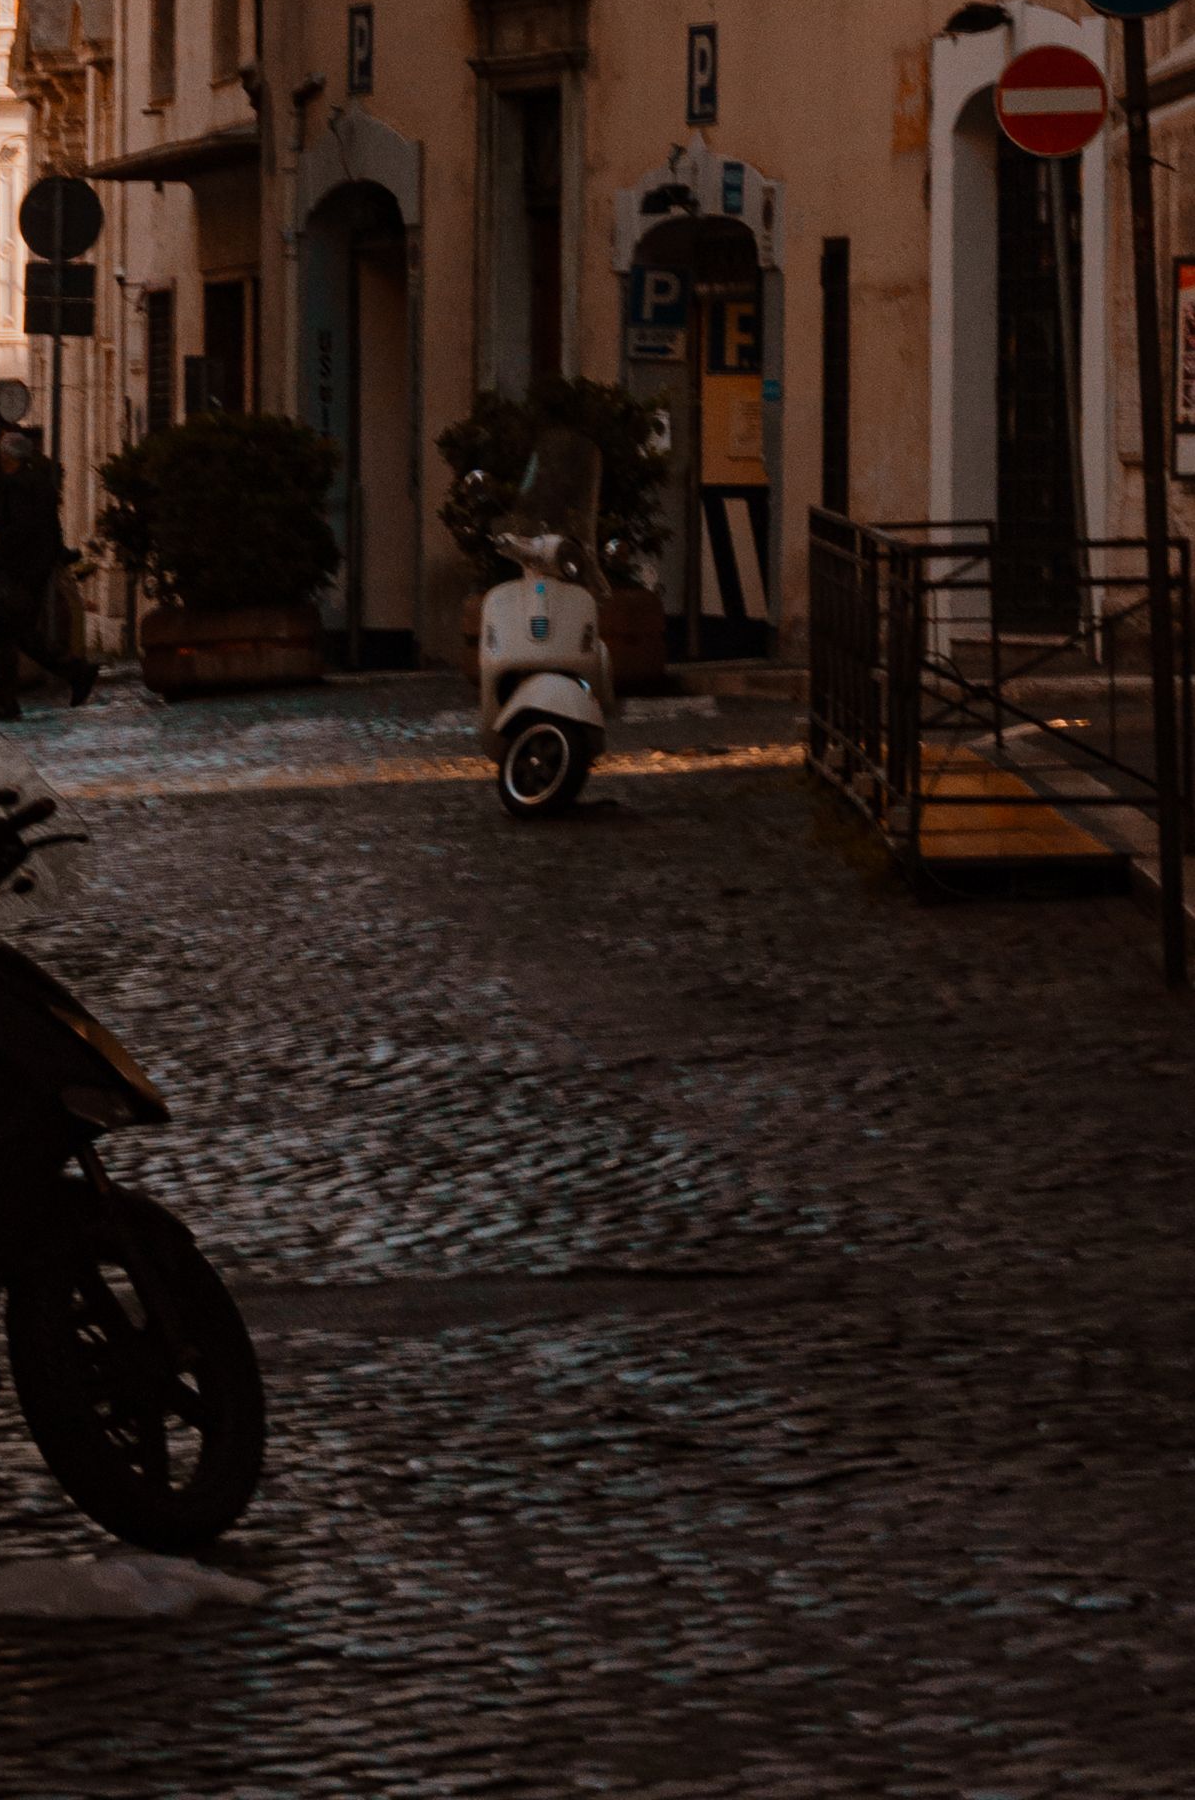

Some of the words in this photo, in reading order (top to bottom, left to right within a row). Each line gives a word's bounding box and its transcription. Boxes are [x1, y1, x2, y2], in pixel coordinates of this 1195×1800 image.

[354, 15, 369, 86] P
[691, 34, 713, 115] P
[642, 269, 683, 318] P
